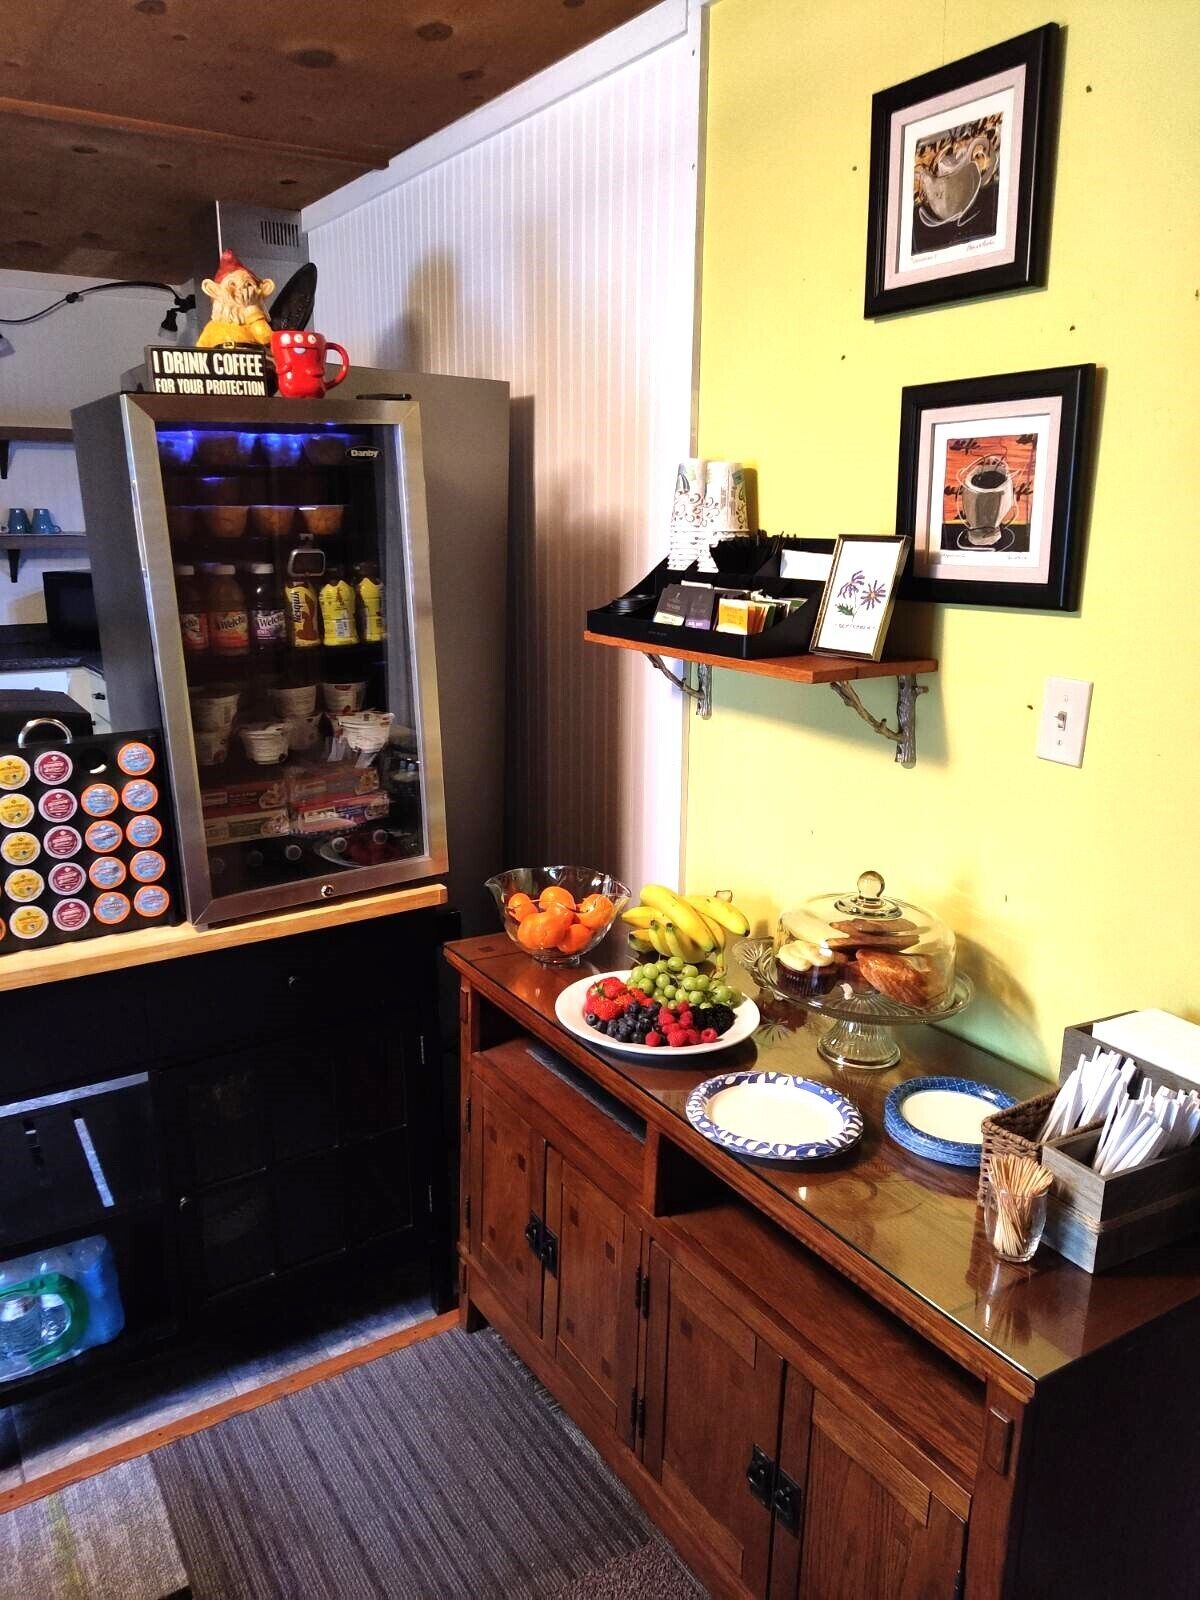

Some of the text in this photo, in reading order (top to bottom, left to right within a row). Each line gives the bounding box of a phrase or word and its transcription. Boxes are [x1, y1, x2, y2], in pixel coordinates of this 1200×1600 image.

[152, 350, 264, 377] I DRINK COFFEE
[155, 378, 266, 397] FOR YOUR PROTECTION
[350, 449, 379, 458] Danby
